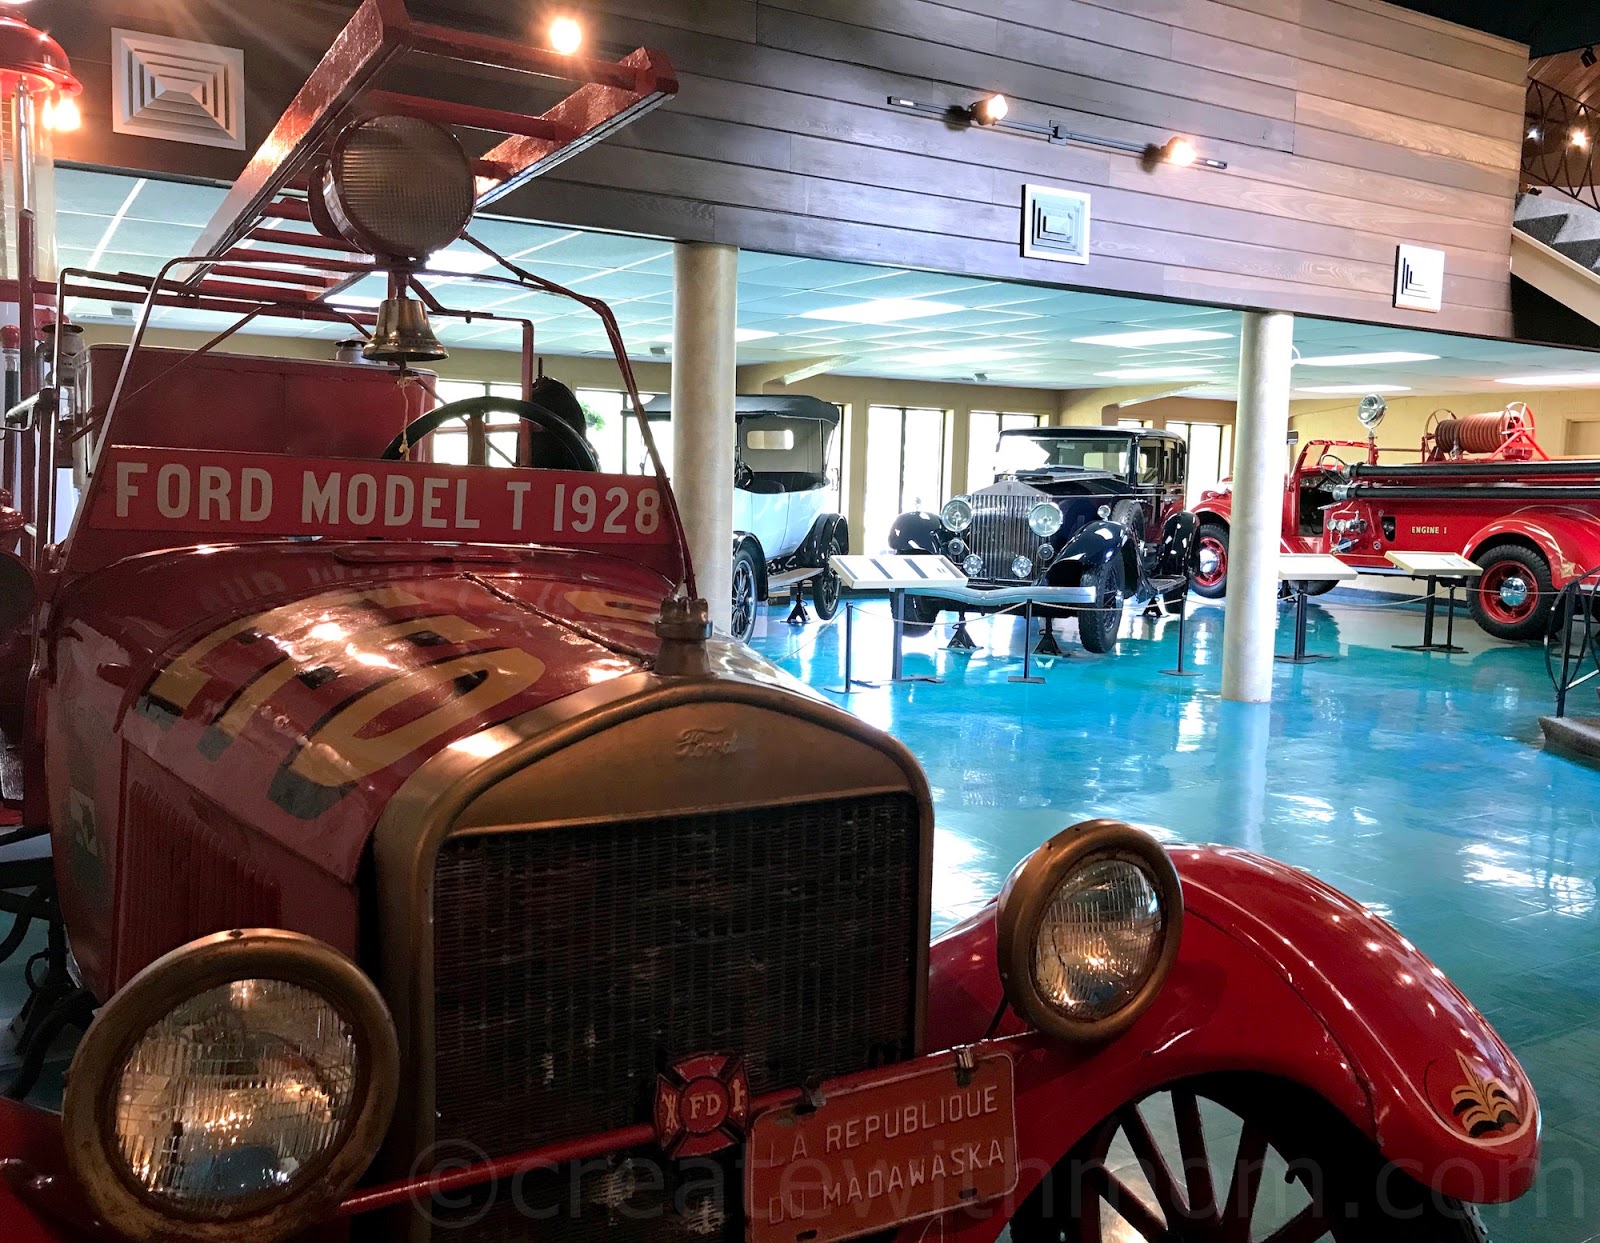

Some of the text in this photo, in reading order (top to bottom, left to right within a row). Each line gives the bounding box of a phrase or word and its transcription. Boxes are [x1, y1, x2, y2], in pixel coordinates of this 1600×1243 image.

[115, 461, 660, 536] FORD MODEL T 1928
[1411, 525, 1440, 534] ENGINE
[674, 727, 738, 757] Ford
[689, 1093, 722, 1120] FD
[769, 1084, 998, 1168] LA REPUBLIQUE
[768, 1139, 1005, 1225] DU MADAWASKA
